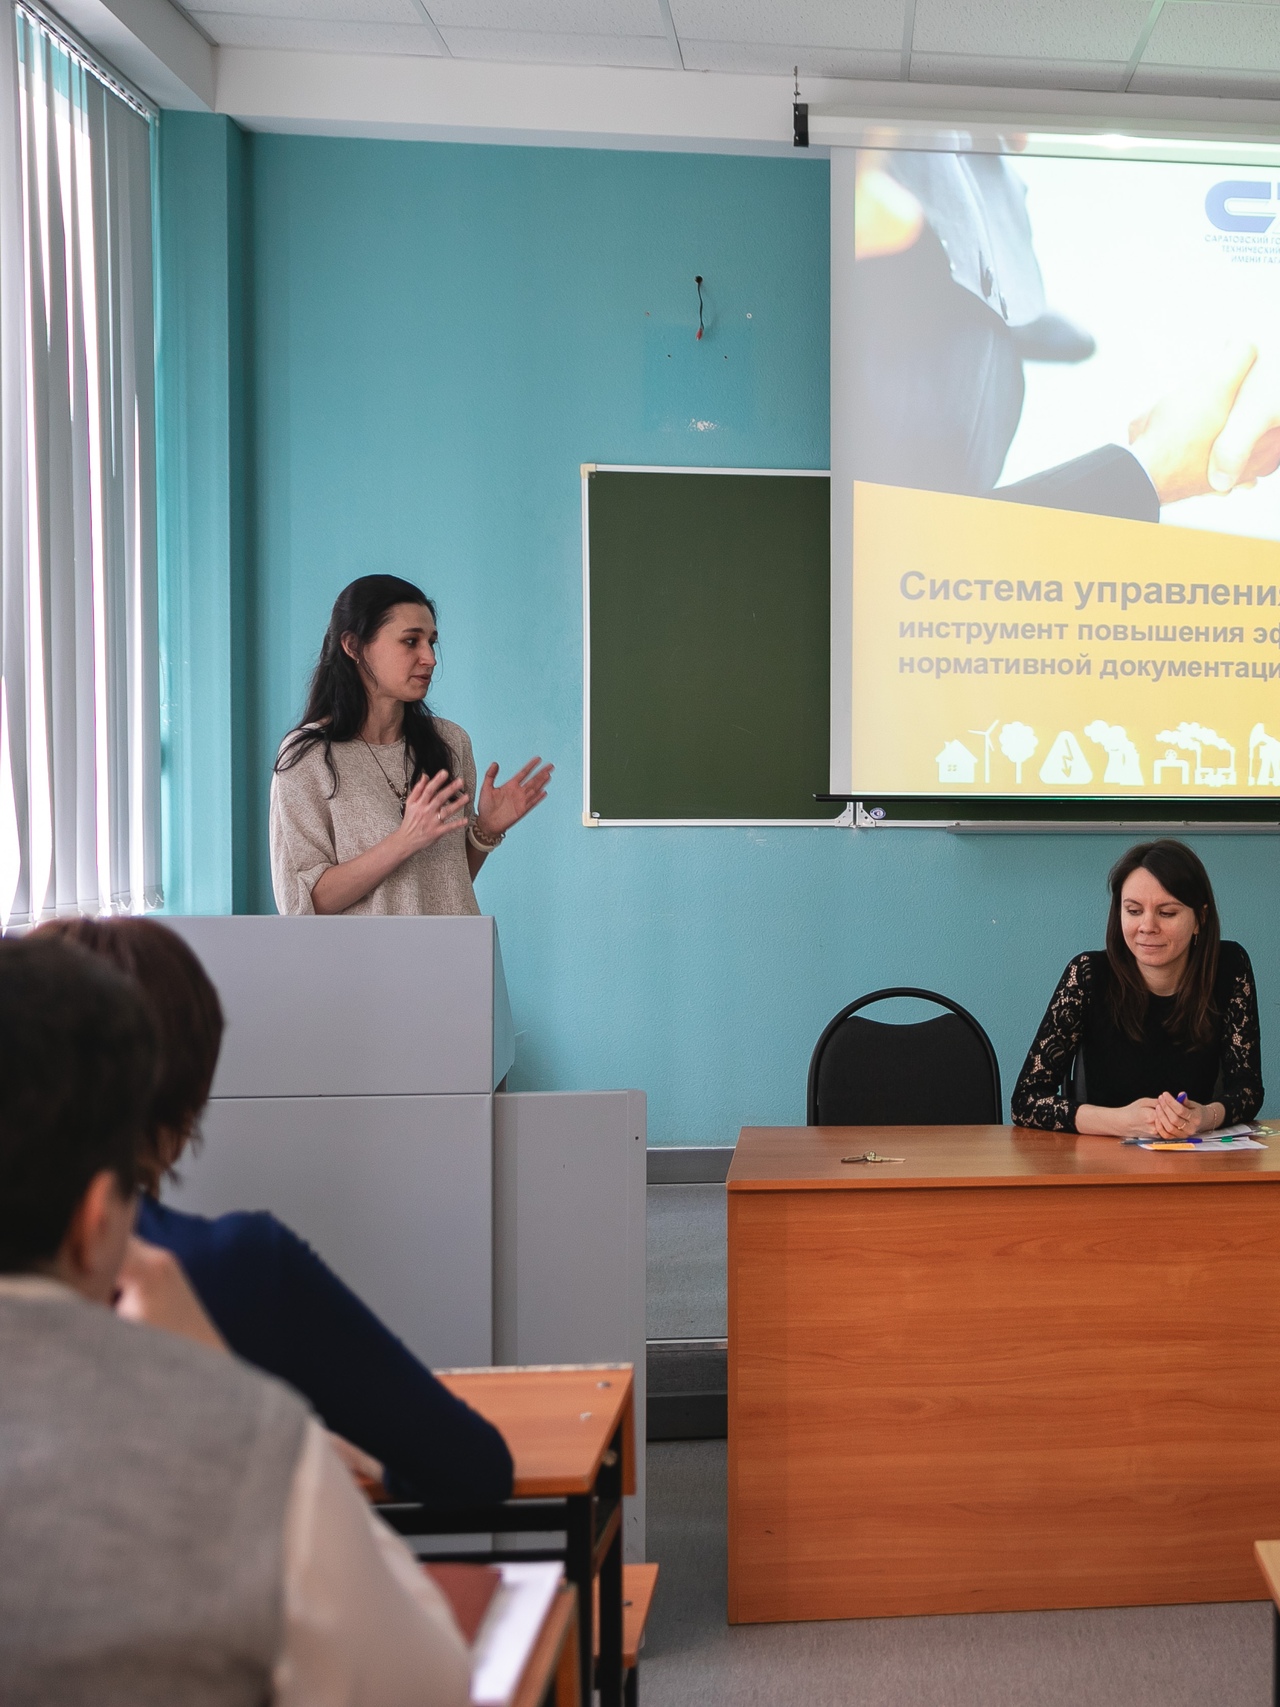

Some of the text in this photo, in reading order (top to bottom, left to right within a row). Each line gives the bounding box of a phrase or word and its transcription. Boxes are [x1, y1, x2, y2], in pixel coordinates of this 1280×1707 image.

[1204, 234, 1269, 245] САРАТОВСКИЙ
[1222, 245, 1280, 255] ТЕХНИЧЕСКИЙ
[1231, 255, 1261, 264] ИМЕНИ
[899, 571, 1063, 602] Система
[899, 621, 1069, 645] инструмент
[1077, 624, 1245, 644] повышения
[899, 653, 1092, 680] нормативной
